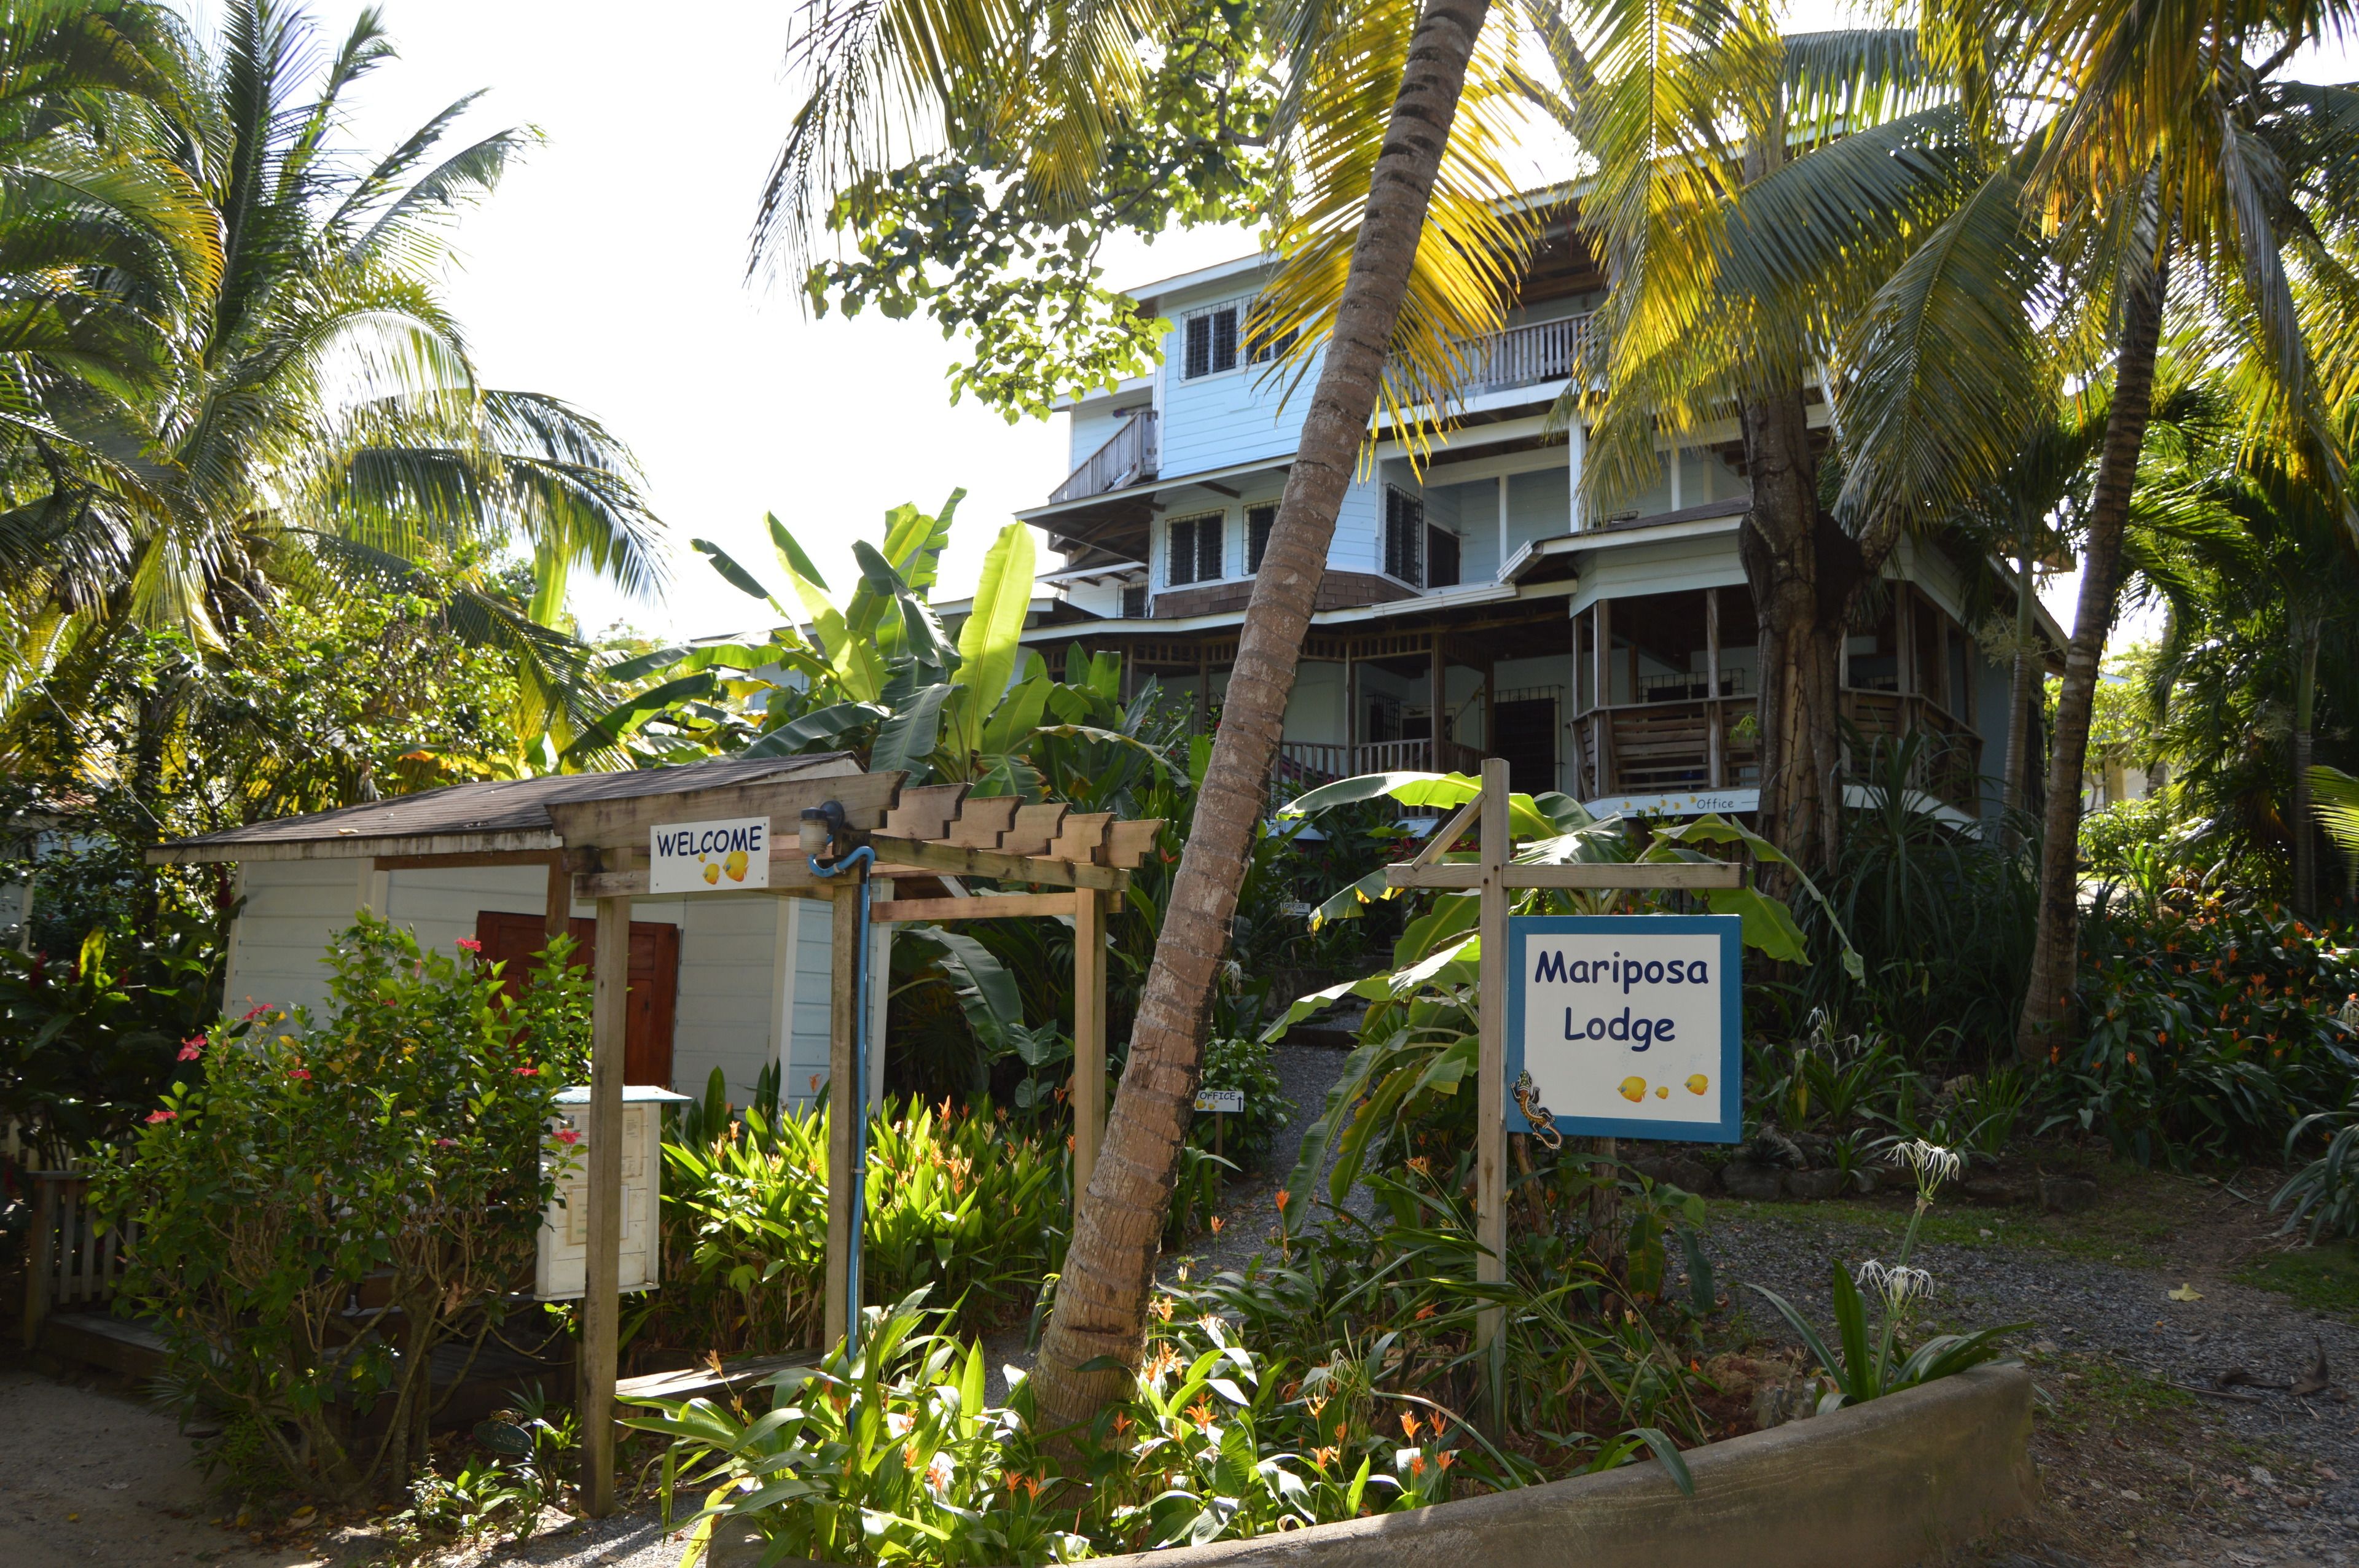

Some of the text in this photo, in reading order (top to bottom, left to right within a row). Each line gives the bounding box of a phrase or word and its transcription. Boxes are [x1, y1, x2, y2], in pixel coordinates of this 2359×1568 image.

[1697, 798, 1734, 809] Office
[657, 826, 762, 857] WELCOME
[1535, 950, 1708, 994] Mariposa
[1565, 1007, 1675, 1051] Lodge
[1199, 1092, 1235, 1101] OFFICE
